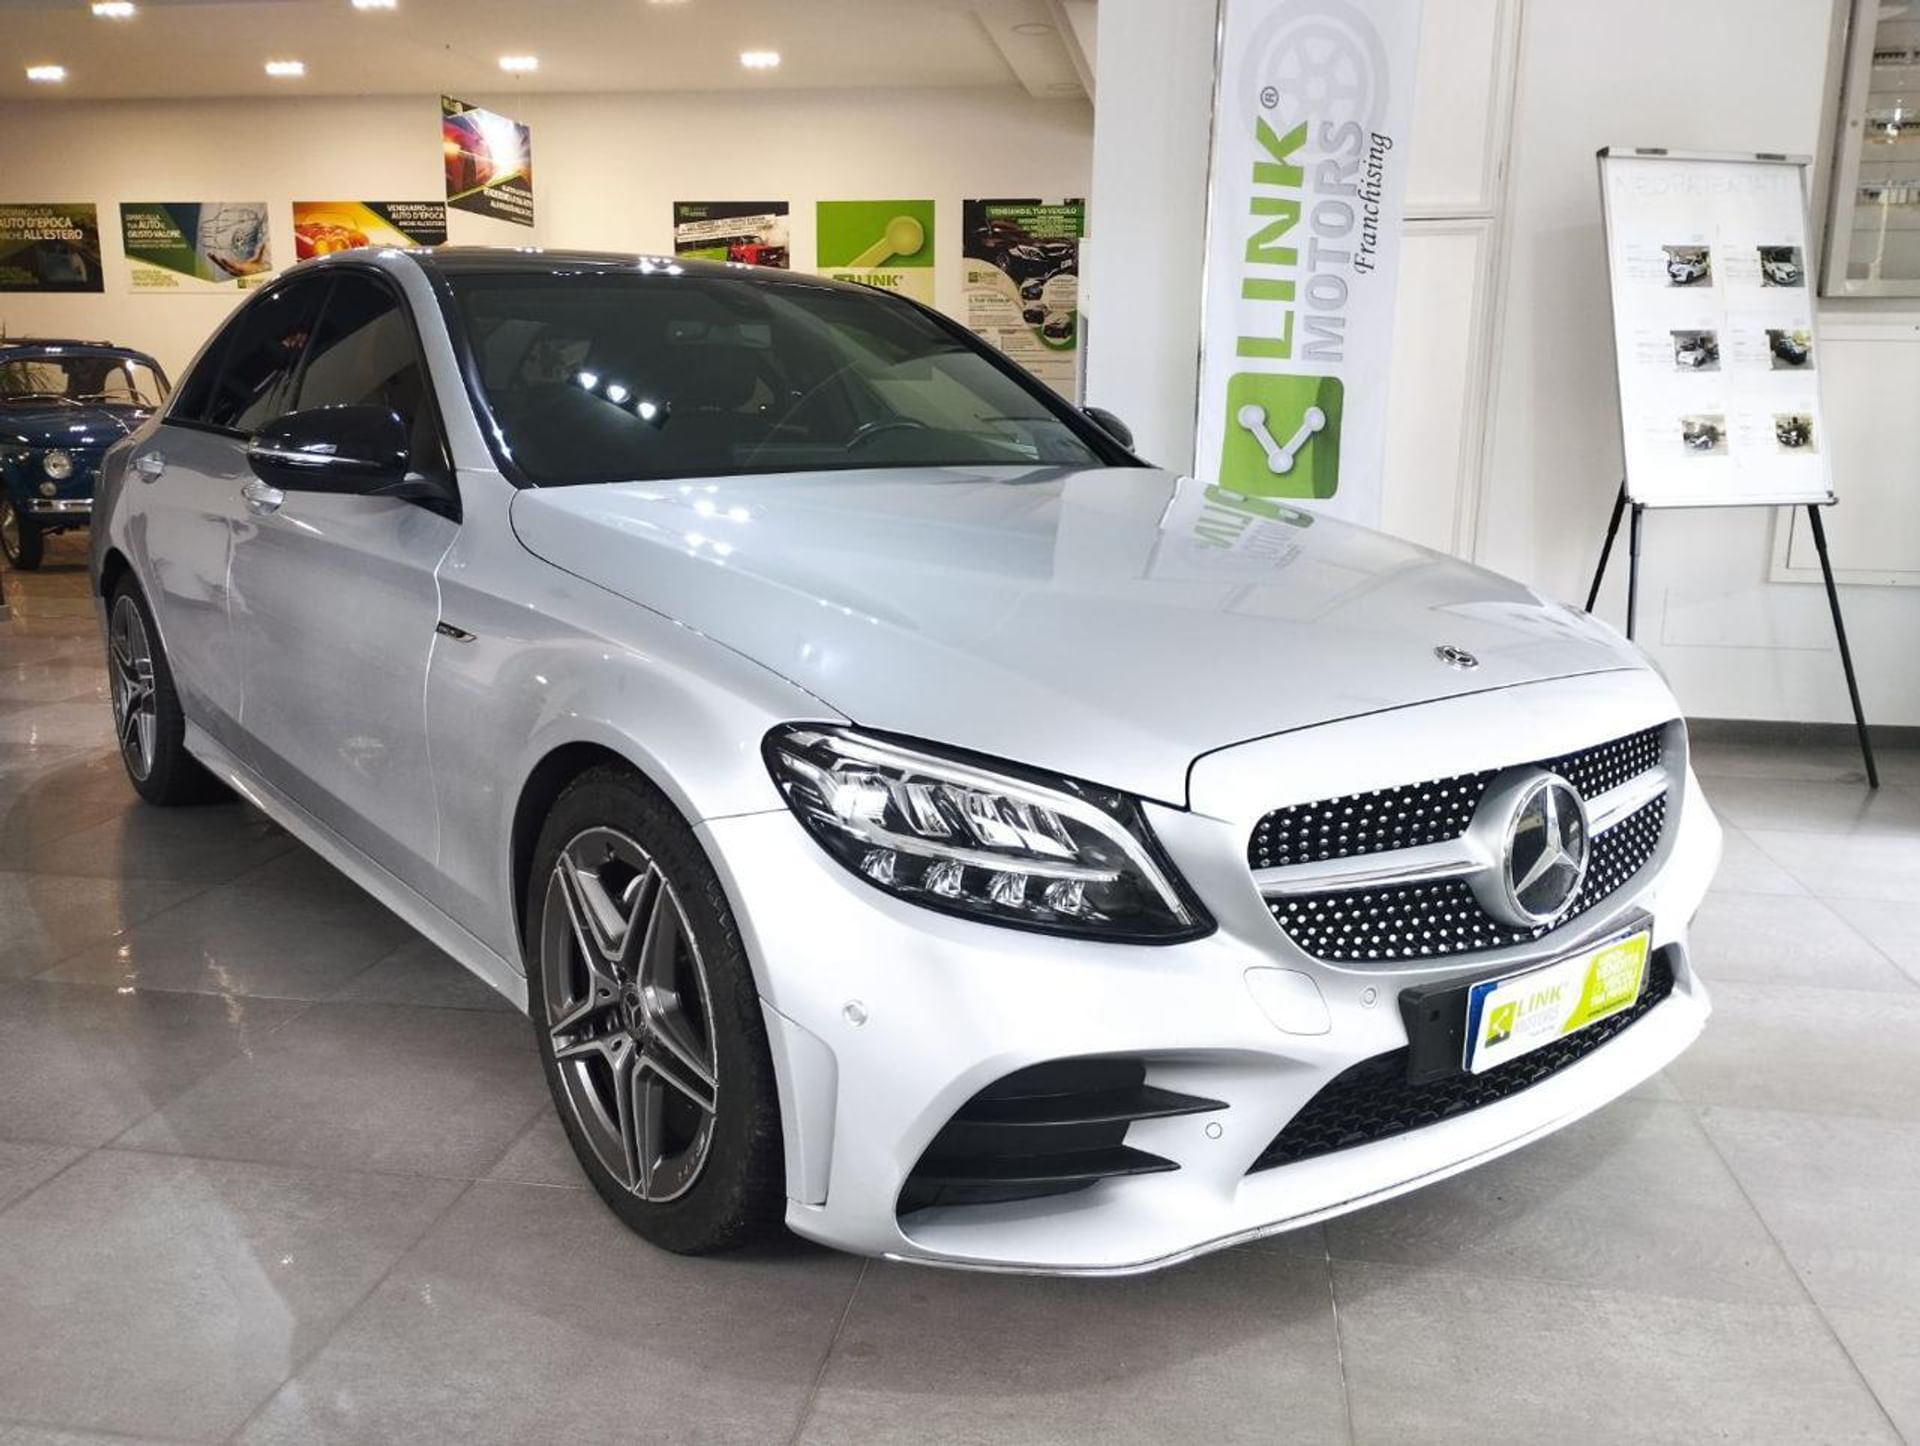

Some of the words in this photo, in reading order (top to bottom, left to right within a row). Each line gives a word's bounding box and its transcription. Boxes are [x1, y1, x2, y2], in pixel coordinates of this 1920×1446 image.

[1353, 132, 1393, 274] Franchising
[391, 211, 412, 219] AUTO
[27, 217, 73, 229] D'EPOCA
[138, 220, 159, 229] AUTO
[24, 229, 83, 240] ALL'ESTERO
[154, 230, 181, 238] VALORE
[1302, 121, 1363, 362] MOTORS
